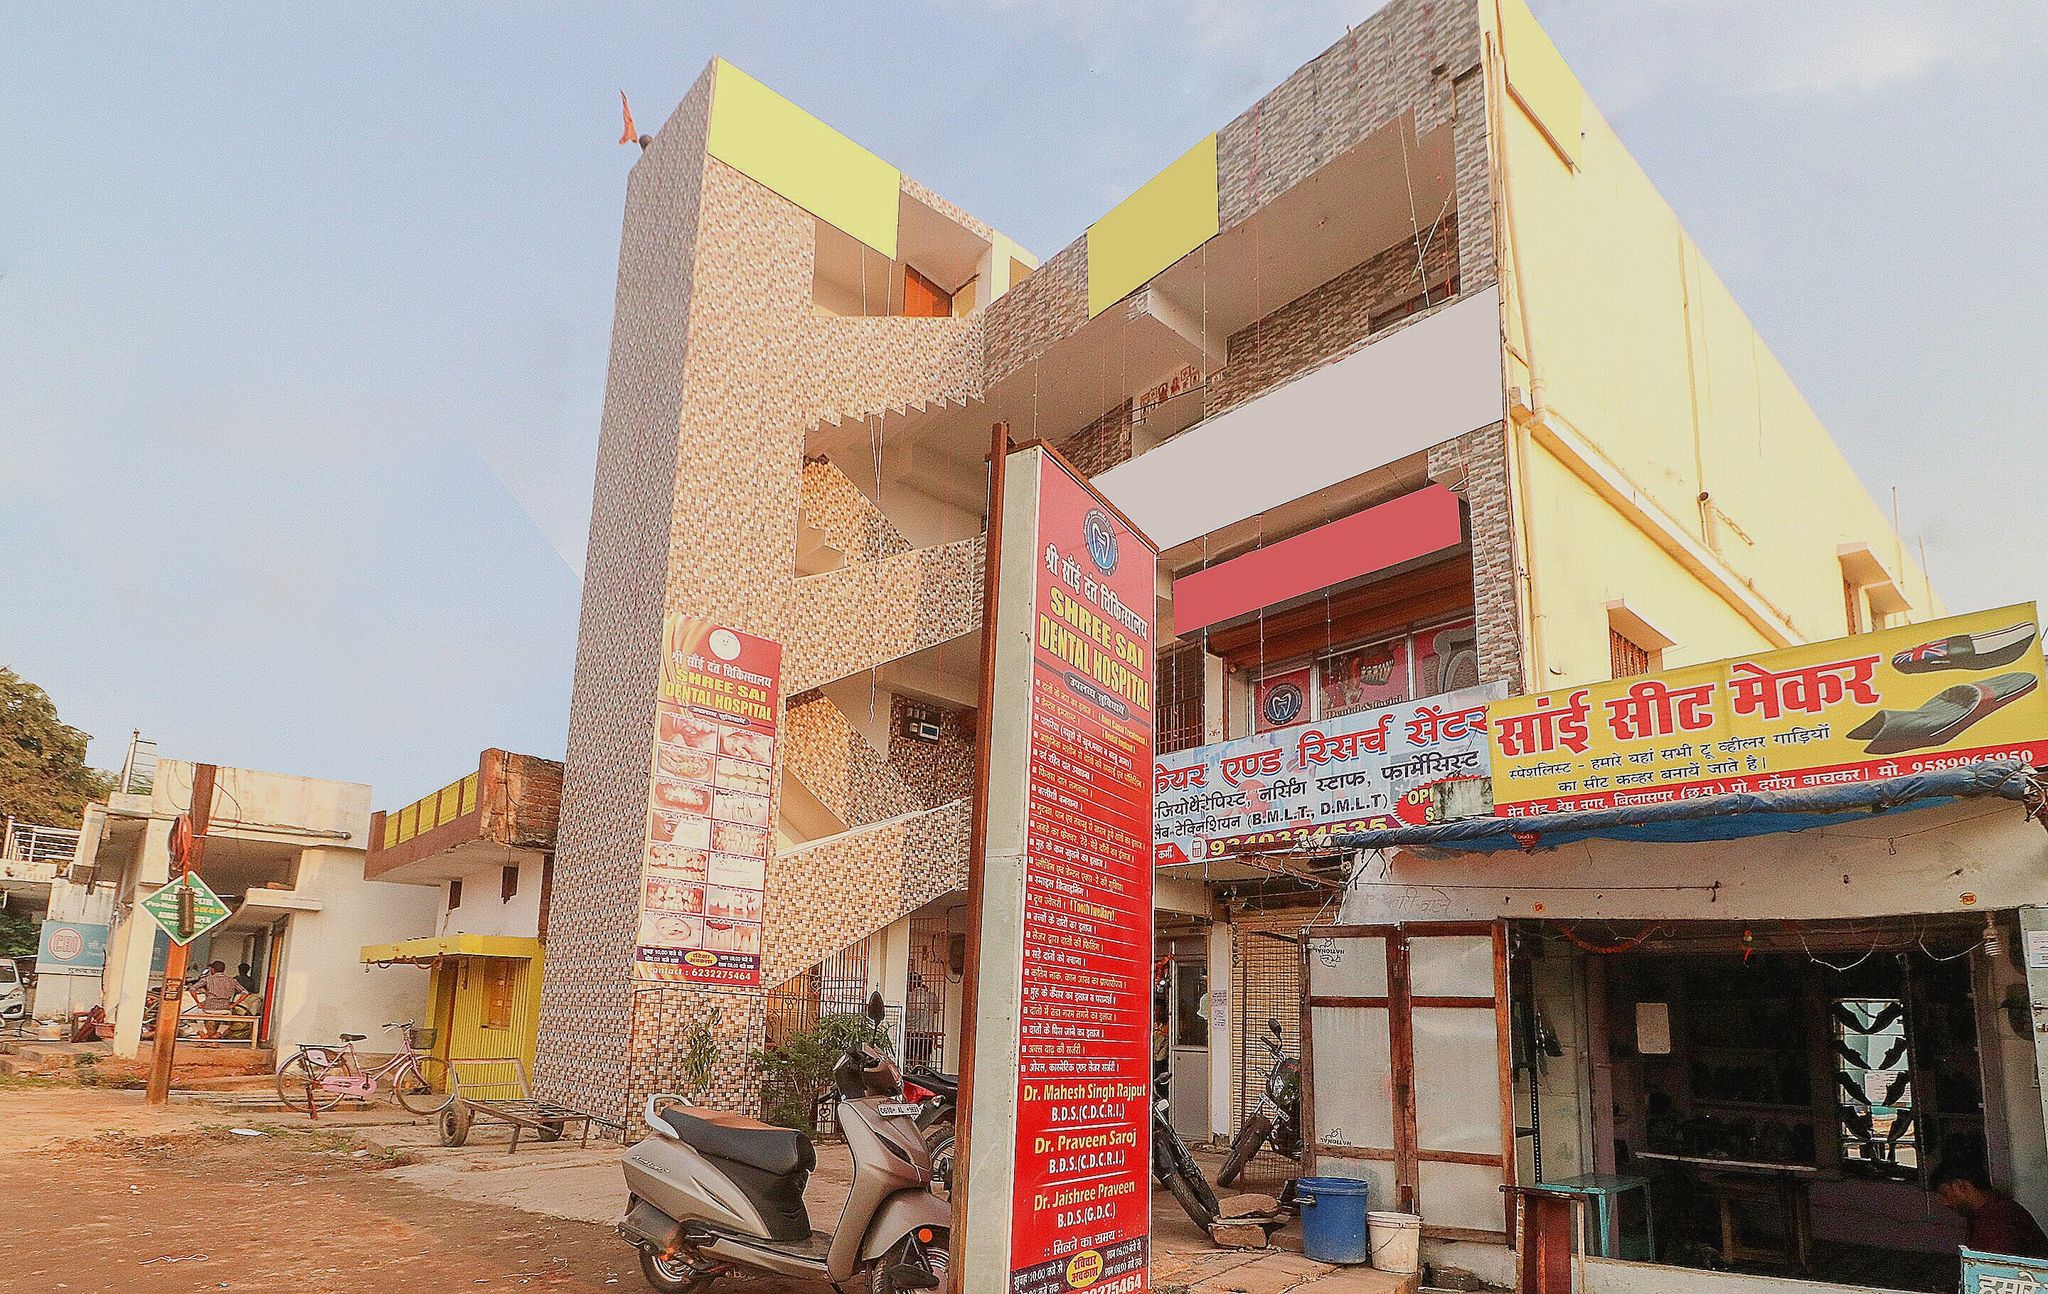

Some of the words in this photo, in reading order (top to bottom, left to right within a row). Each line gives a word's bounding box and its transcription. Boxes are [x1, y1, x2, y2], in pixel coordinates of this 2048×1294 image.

[1050, 585, 1112, 651] SHREE
[1114, 631, 1144, 673] SAI
[1039, 613, 1091, 677] DENTAL
[1093, 649, 1150, 712] HOSPITAL
[665, 681, 711, 706] DENTAL
[714, 695, 773, 722] HOSPITAL
[675, 668, 734, 694] SHREE
[737, 683, 767, 703] SAI
[1605, 678, 1716, 742] सीट
[1728, 653, 1882, 722] मेकर
[1220, 748, 1284, 788] एण्ड
[1297, 714, 1396, 770] रिसर्च
[1405, 704, 1489, 747] सेंटर
[1509, 762, 1572, 780] स्पेशलिस्ट
[1590, 752, 1622, 770] हमारे
[1628, 748, 1654, 763] यहां
[1662, 744, 1692, 760] सभी
[1700, 744, 1715, 760] टू
[1718, 736, 1766, 753] व्हीलर
[1773, 724, 1830, 744] गाड़ियों
[1508, 804, 1524, 818] मेन
[1878, 762, 1904, 777] मो.
[1558, 781, 1576, 792] का
[1584, 775, 1610, 789] सीट
[1616, 771, 1654, 785] कव्हर
[1660, 763, 1700, 780] बनायें
[1707, 758, 1738, 774] जाते
[691, 968, 751, 980] 6232275464
[1024, 1085, 1041, 1102] Dr.
[1043, 1085, 1085, 1101] Mahesh
[1088, 1083, 1115, 1103] Singh
[1117, 1083, 1146, 1102] Rajput
[1035, 1137, 1054, 1154] Dr.
[1058, 1133, 1106, 1150] Praveen
[1109, 1129, 1137, 1147] Saroj
[1034, 1194, 1050, 1211] Dr.
[1053, 1187, 1096, 1208] Jaishree
[1098, 1180, 1135, 1199] Praveen
[1053, 1236, 1077, 1255] मिलने
[1081, 1238, 1092, 1247] का
[1095, 1230, 1116, 1244] समय
[1071, 1266, 1099, 1282] अवकाश
[1074, 1256, 1097, 1270] रविवार
